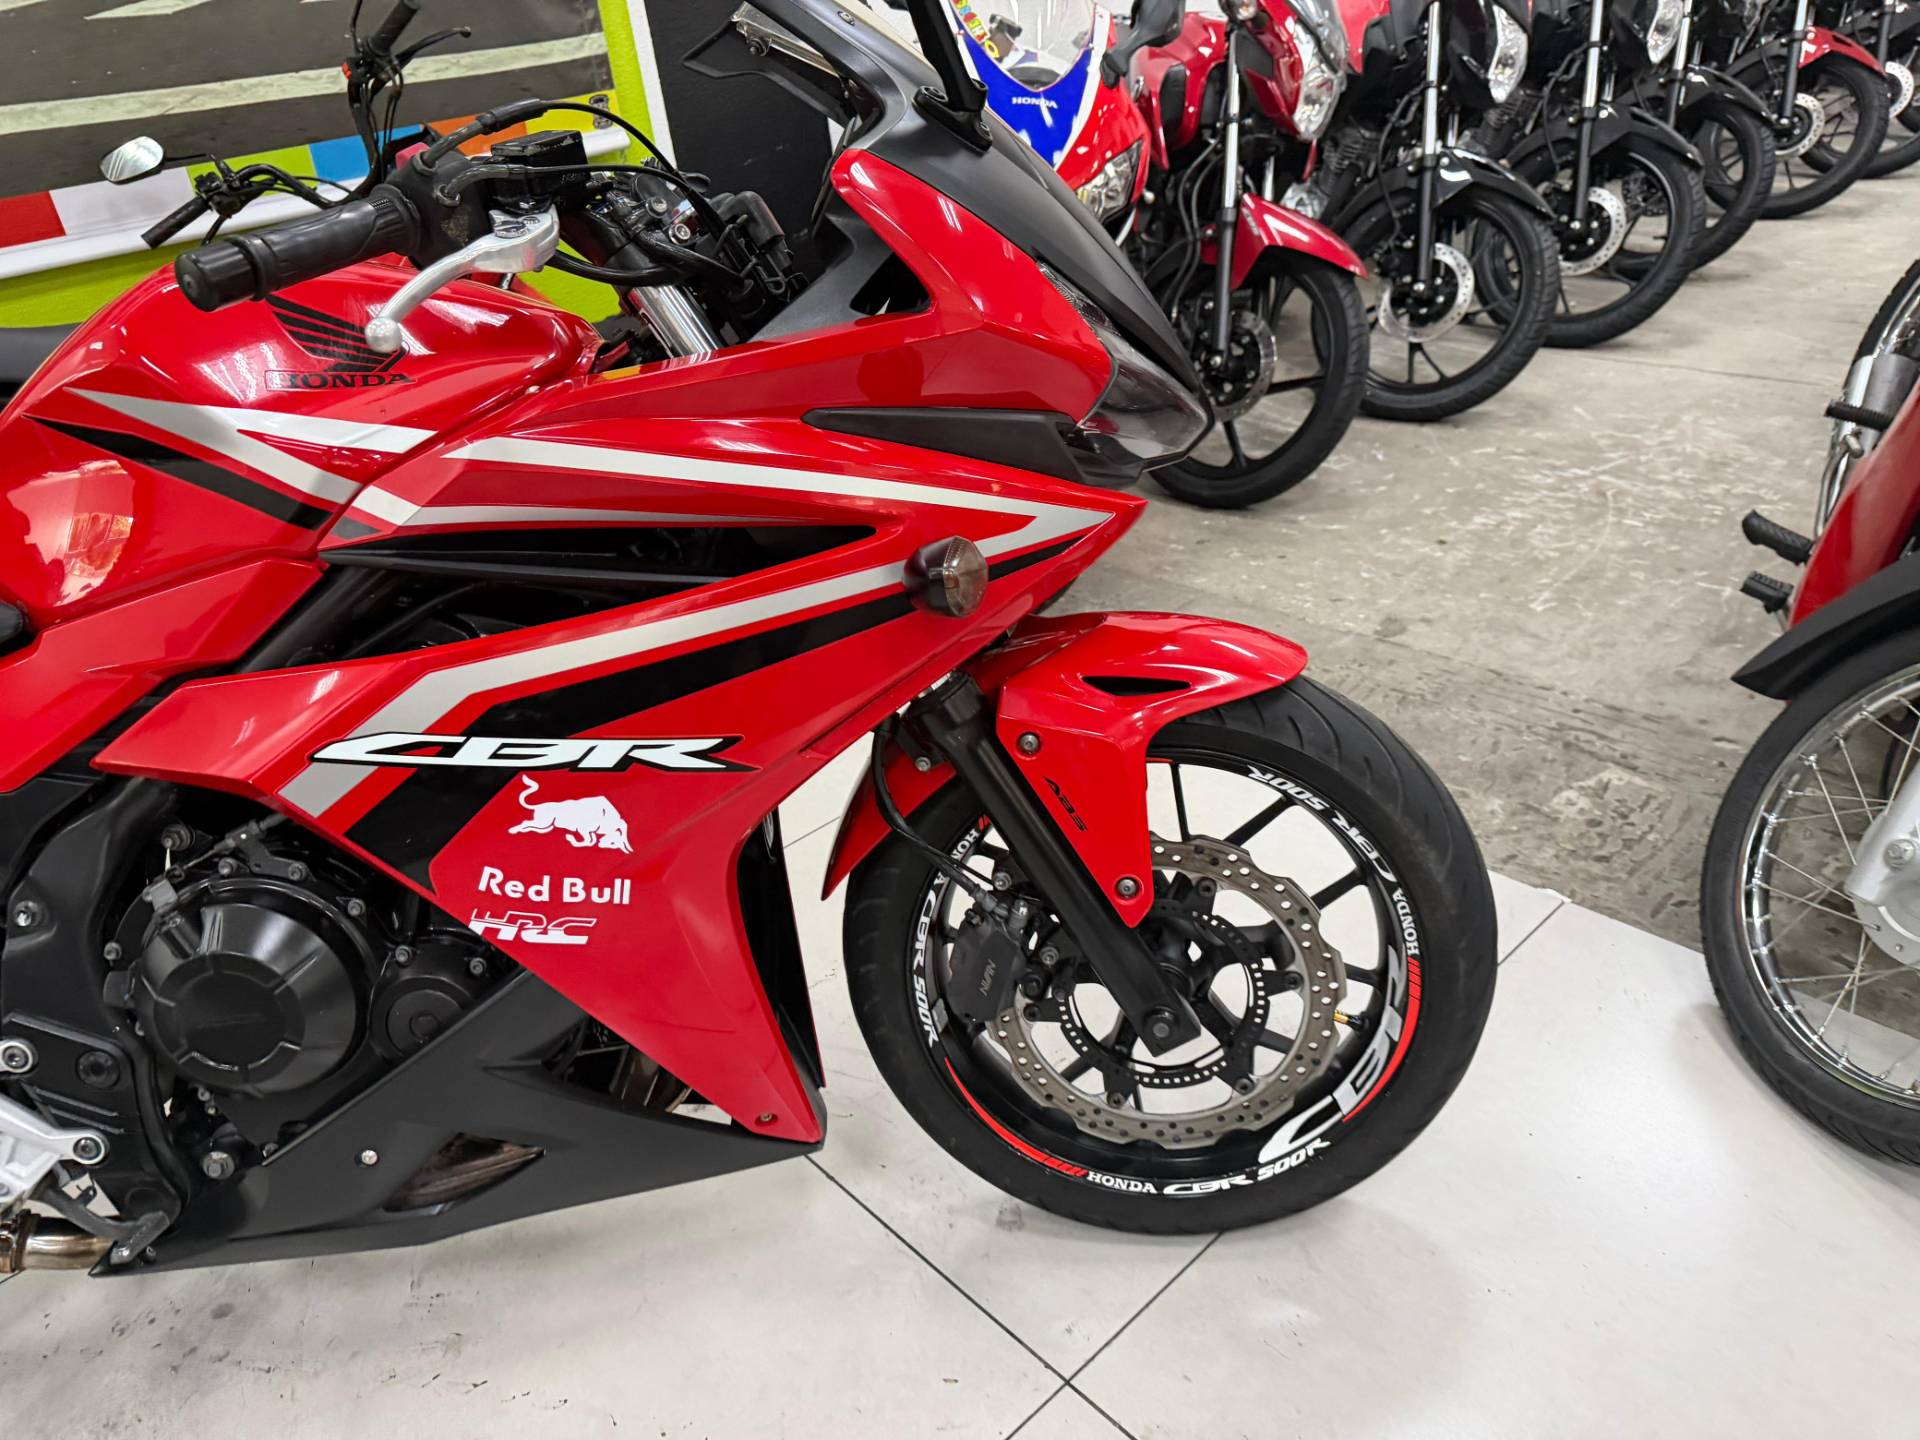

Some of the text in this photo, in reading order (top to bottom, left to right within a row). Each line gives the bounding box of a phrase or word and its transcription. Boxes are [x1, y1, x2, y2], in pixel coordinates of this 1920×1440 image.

[1011, 96, 1058, 109] HONDA
[312, 731, 732, 770] CBR
[1044, 776, 1088, 832] ABS
[1247, 765, 1419, 956] HONDA CBR 500R
[478, 866, 631, 904] Red Bull
[467, 908, 597, 944] HRC
[913, 828, 980, 1047] HONA CBR 500R
[1087, 1138, 1331, 1195] HONDA CBR 500R
